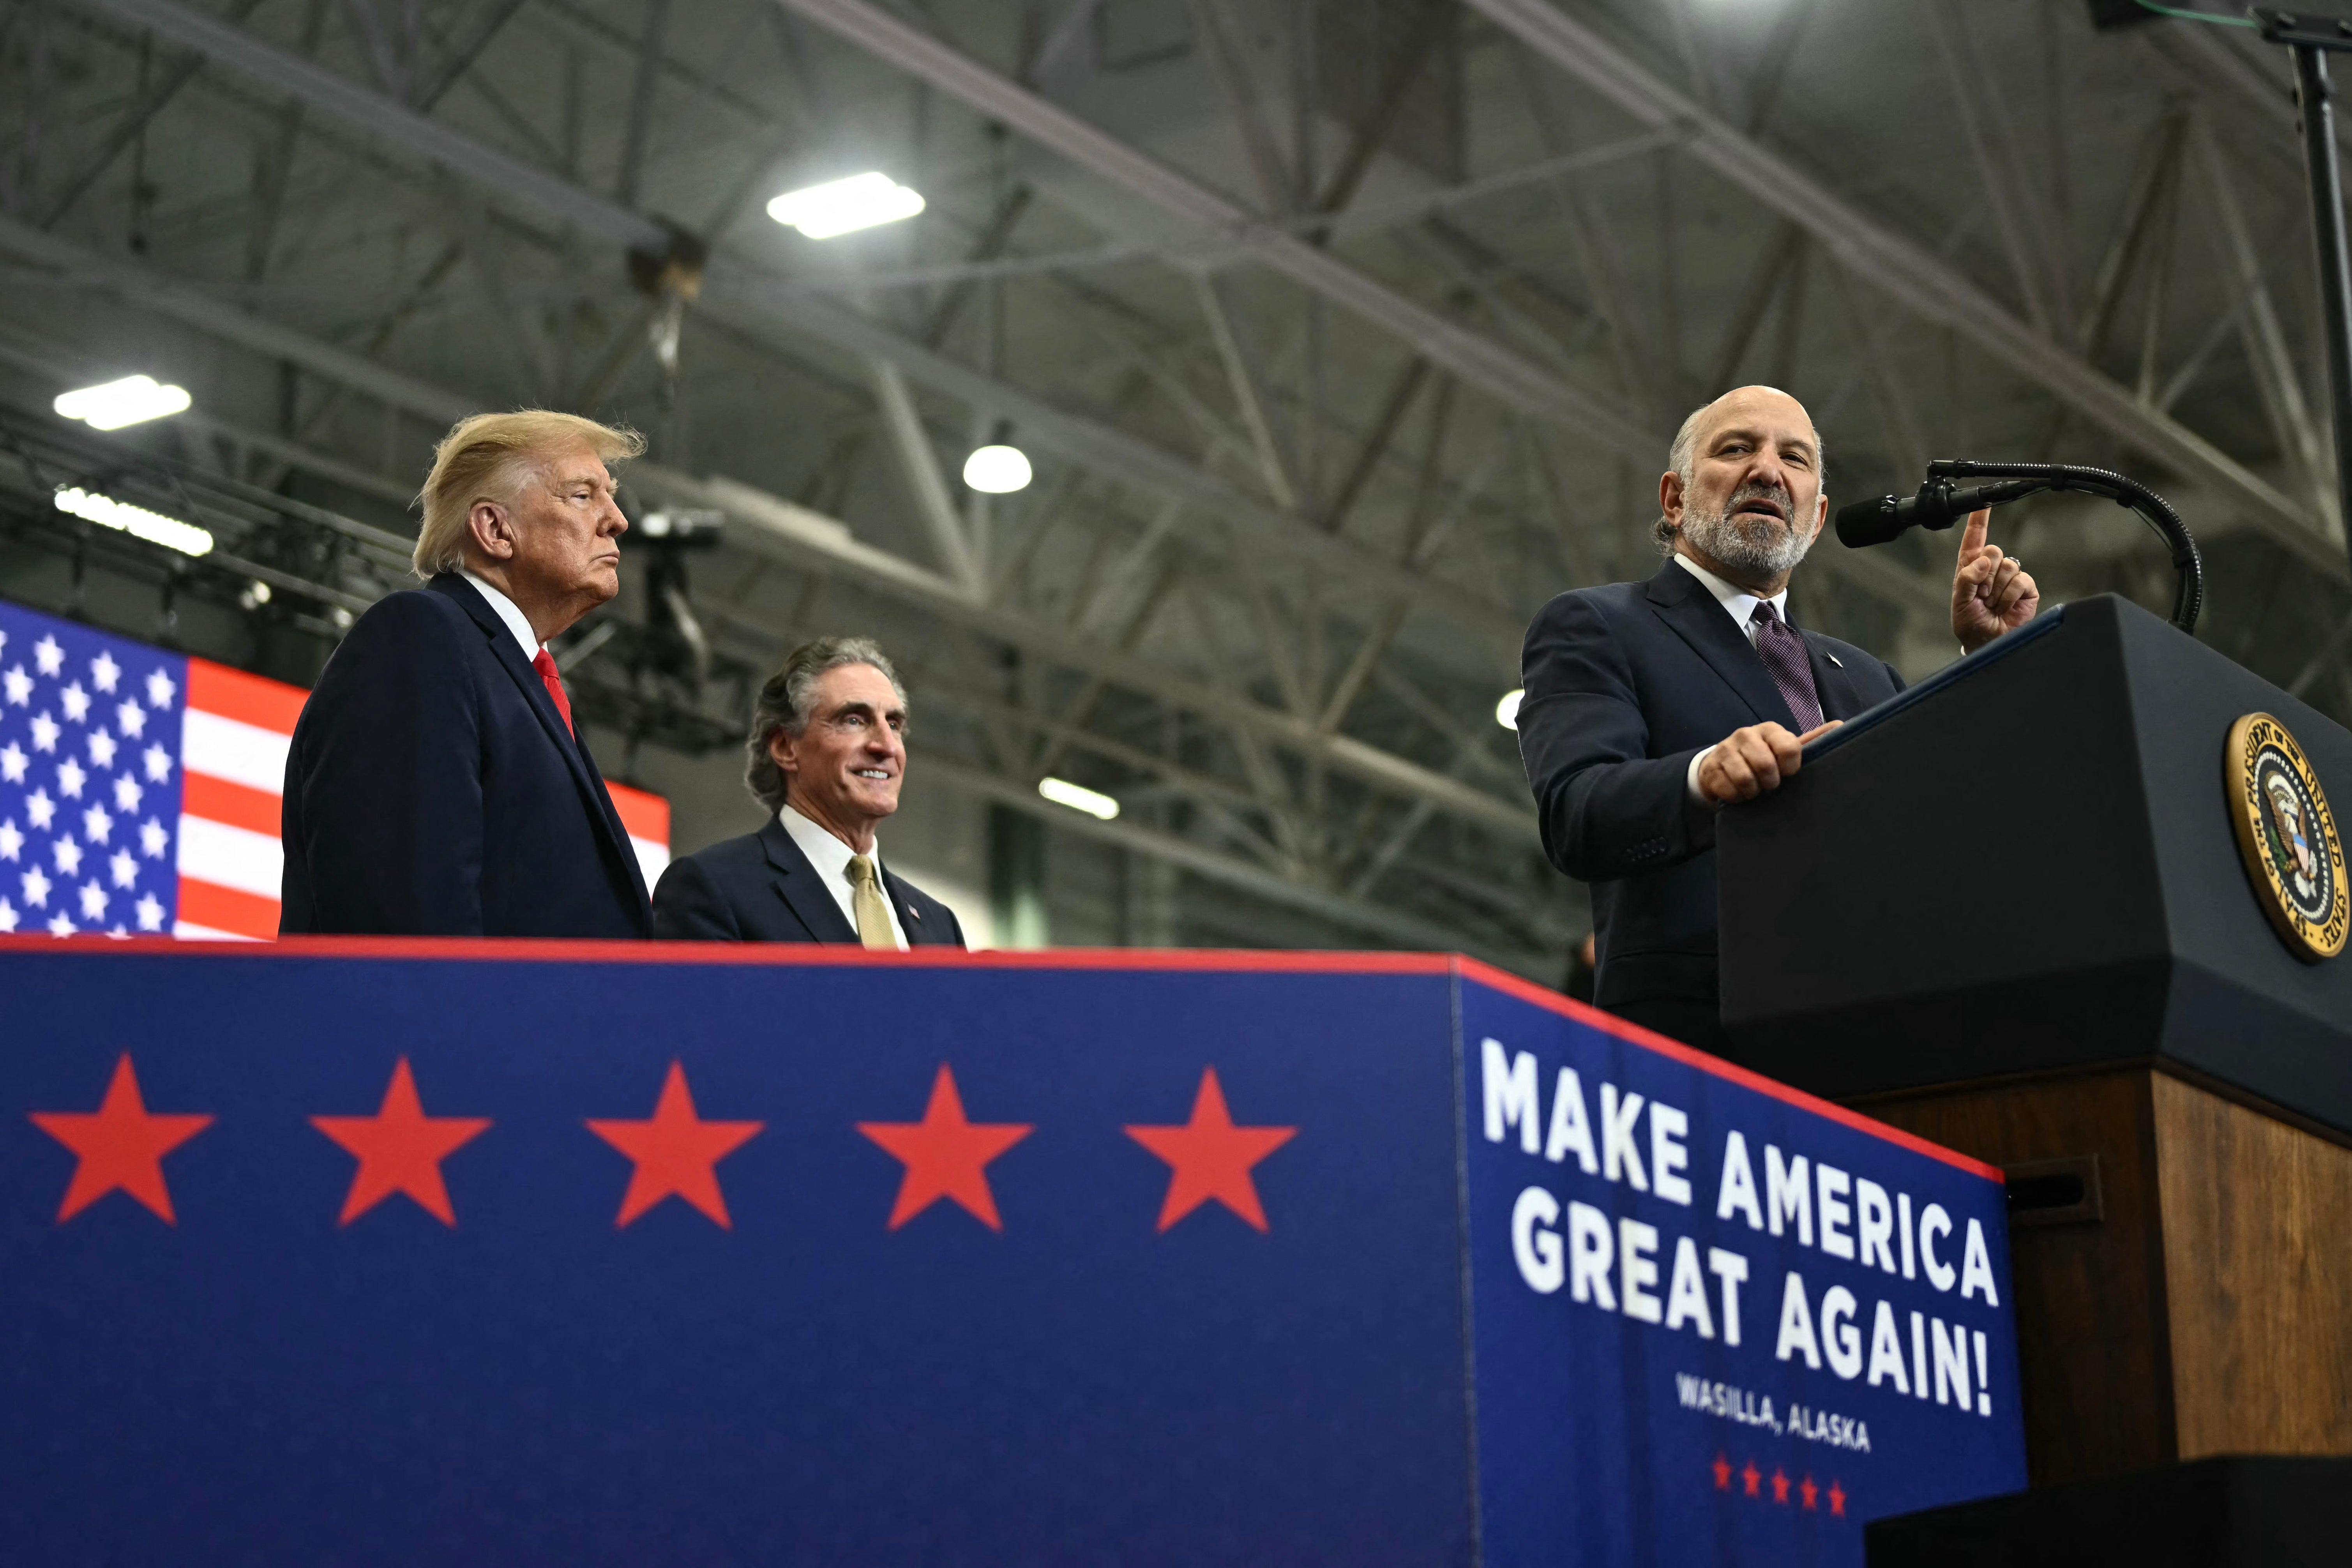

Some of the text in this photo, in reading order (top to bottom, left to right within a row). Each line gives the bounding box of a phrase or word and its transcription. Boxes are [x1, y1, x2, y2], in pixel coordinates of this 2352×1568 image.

[2306, 766, 2342, 868] UNITED
[1481, 1037, 1999, 1307] MAKE AMERICA
[1511, 1185, 1992, 1417] GREAT AGAIN!
[1676, 1372, 1871, 1453] WASILLA, ALASKA
